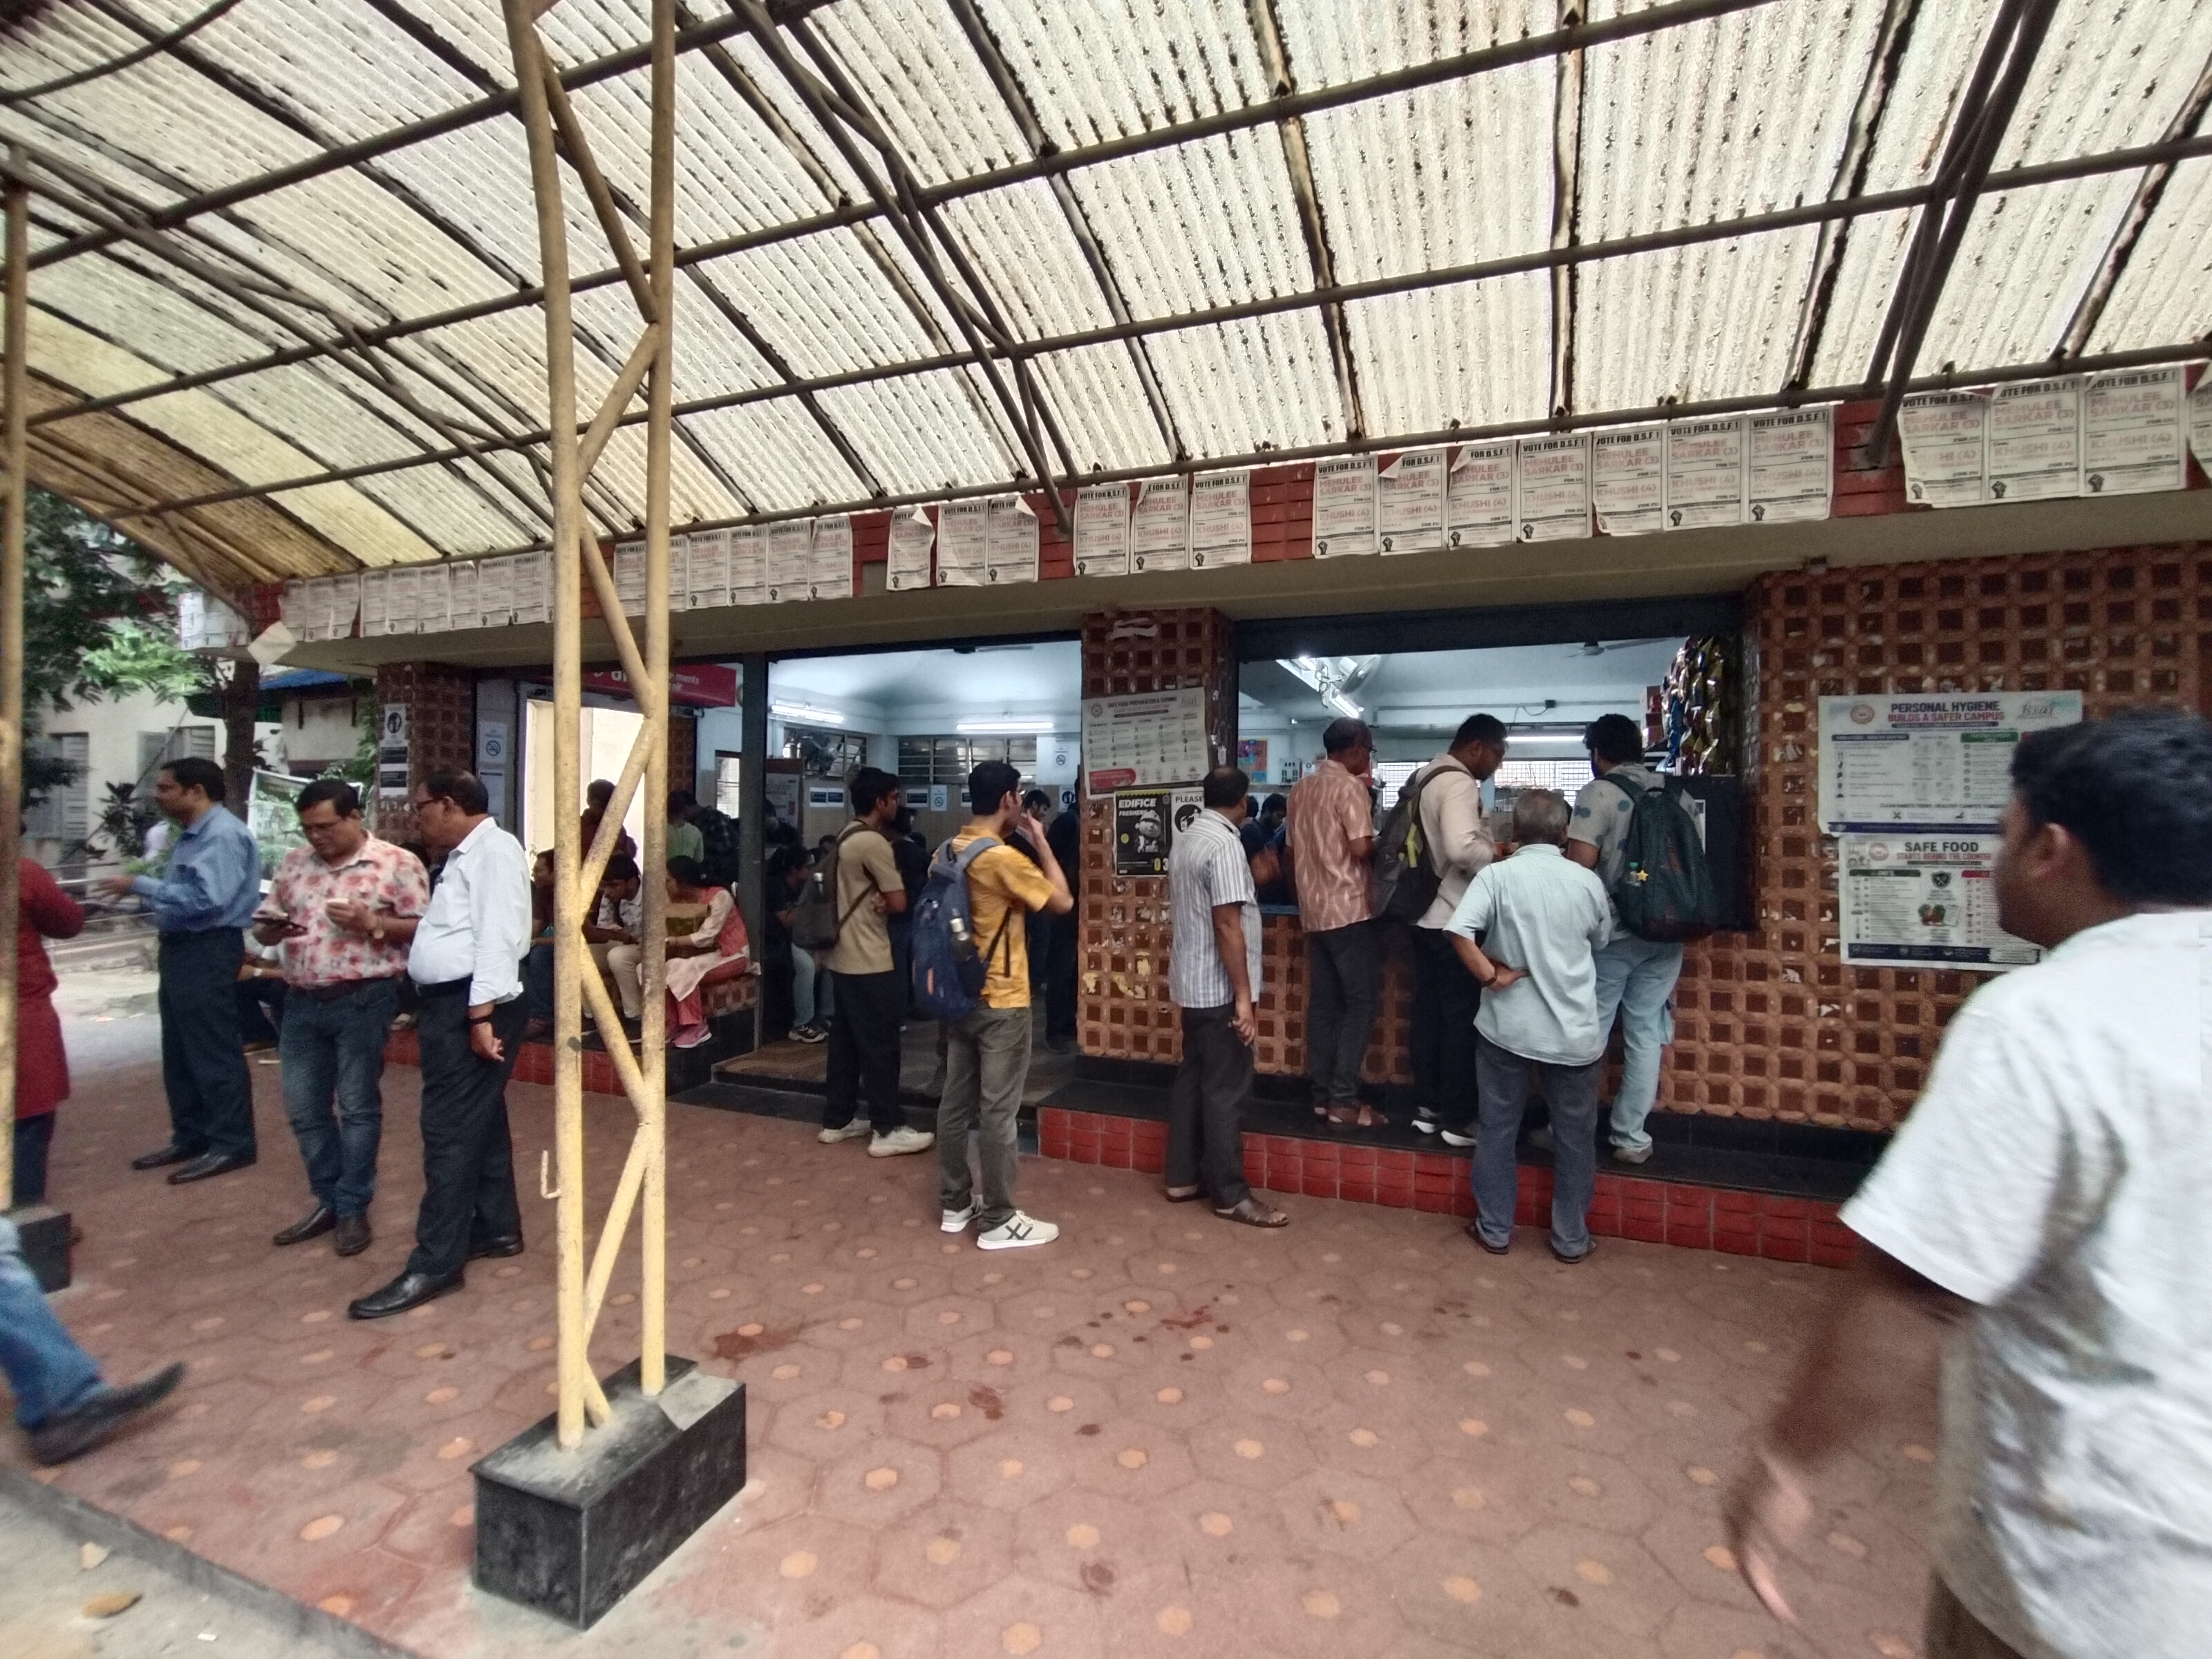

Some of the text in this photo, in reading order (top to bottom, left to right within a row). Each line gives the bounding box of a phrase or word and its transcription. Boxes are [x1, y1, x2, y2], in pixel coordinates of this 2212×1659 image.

[2000, 385, 2041, 397] OTE FOR
[1902, 395, 1948, 407] VOTE FOR
[1754, 420, 1775, 428] VOTE
[1777, 417, 1794, 425] FOR
[1617, 435, 1631, 443] FOR
[1470, 450, 1485, 458] FOR
[1596, 448, 1649, 460] MEHULEE
[1671, 449, 1716, 460] SARKAR
[1524, 455, 1575, 467] MEHULEE
[1596, 458, 1641, 470] SARKAR
[1318, 465, 1334, 474] VOTE
[1524, 465, 1568, 476] SARKAR
[1452, 473, 1493, 484] SARKAR
[1320, 485, 1357, 496] SARKAR
[1384, 480, 1424, 491] SARKAR
[1596, 485, 1638, 496] KHUSHI
[1196, 491, 1237, 503] MEHULEE
[1138, 505, 1171, 514] SARKAR
[1196, 499, 1231, 510] SARKAR
[1452, 499, 1490, 510] KHUSHI
[991, 521, 1021, 529] SARKAR
[1197, 523, 1228, 534] KHUSHI
[1138, 528, 1168, 537] KHUSHI
[1079, 534, 1110, 543] KHUSHI
[1891, 701, 2000, 713] PERSONAL HYGIENE
[1888, 712, 2005, 722] BUILDS A SAFER CAMPUS
[1118, 798, 1156, 808] EDIFICE
[1905, 842, 1978, 852] SAFE FOOD
